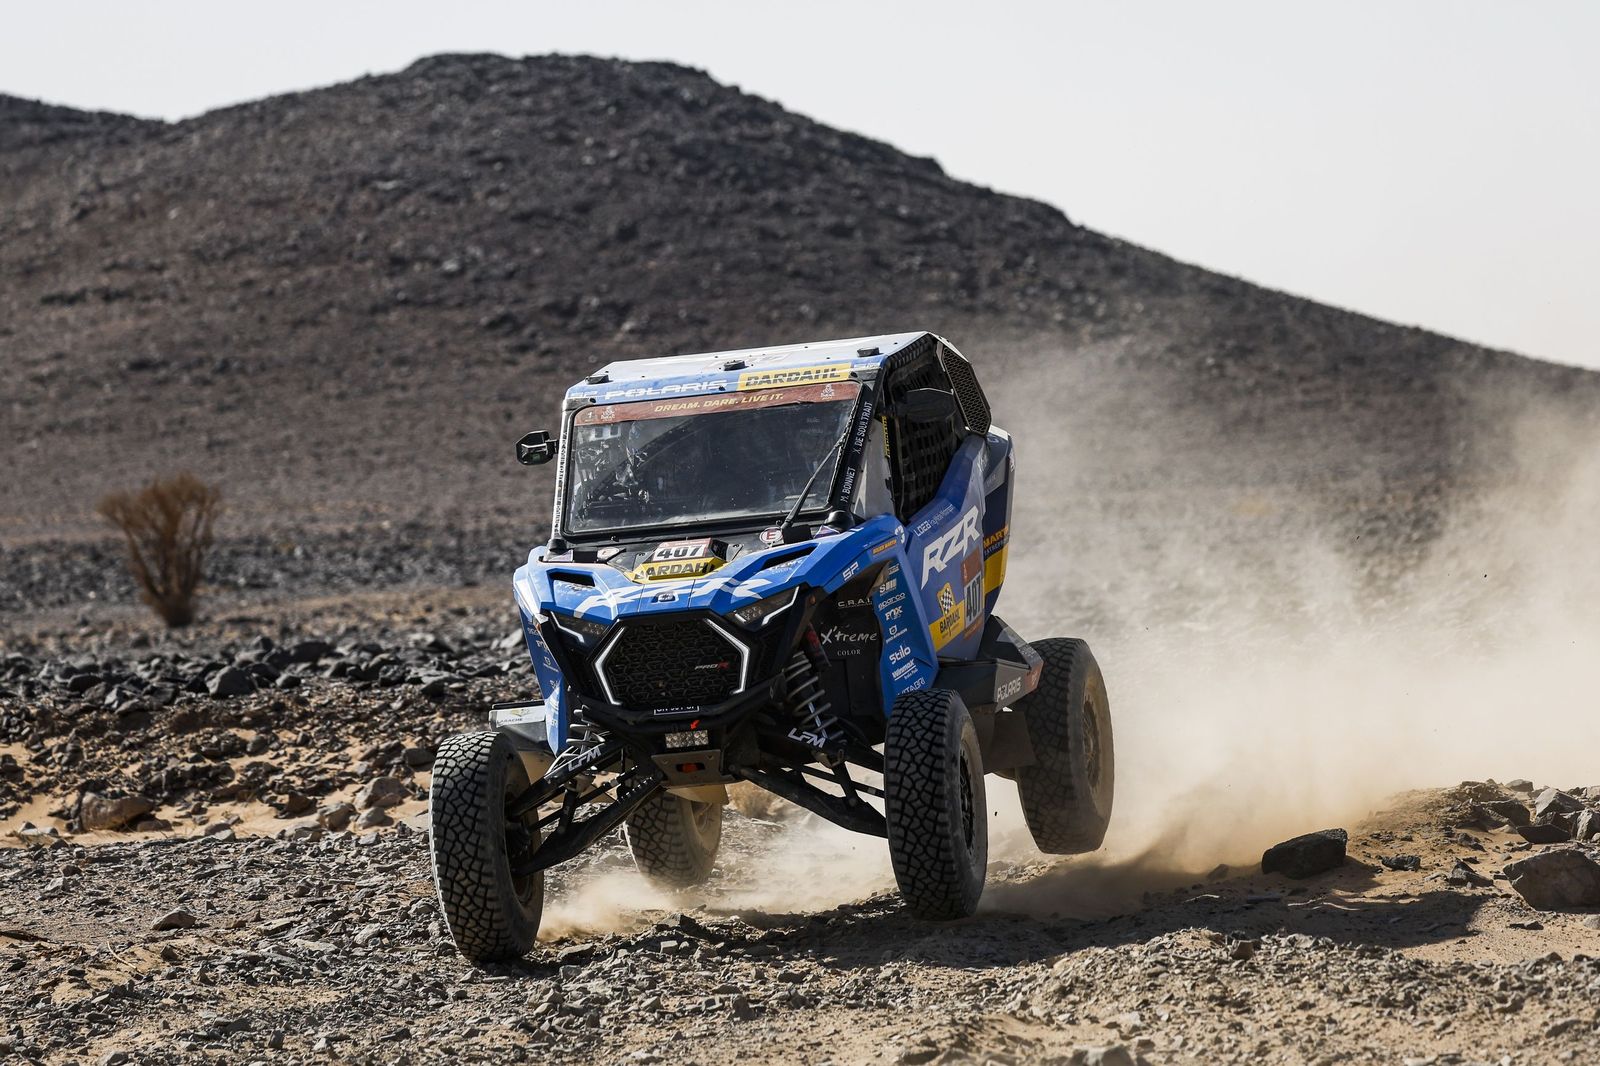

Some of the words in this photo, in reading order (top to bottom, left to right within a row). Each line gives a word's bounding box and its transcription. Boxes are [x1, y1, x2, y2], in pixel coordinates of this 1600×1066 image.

[746, 367, 841, 387] BARDAHL
[605, 379, 727, 400] POLARIS
[654, 401, 701, 413] DREAM.
[702, 397, 739, 409] DARE.
[739, 394, 770, 404] LIVE
[769, 393, 785, 401] IT.
[842, 466, 856, 494] BONNET
[656, 546, 701, 560] 407
[920, 504, 981, 591] RZR
[965, 573, 981, 622] 407
[837, 648, 861, 657] COLOR
[997, 676, 1022, 703] POLARIS
[787, 727, 828, 749] LFM
